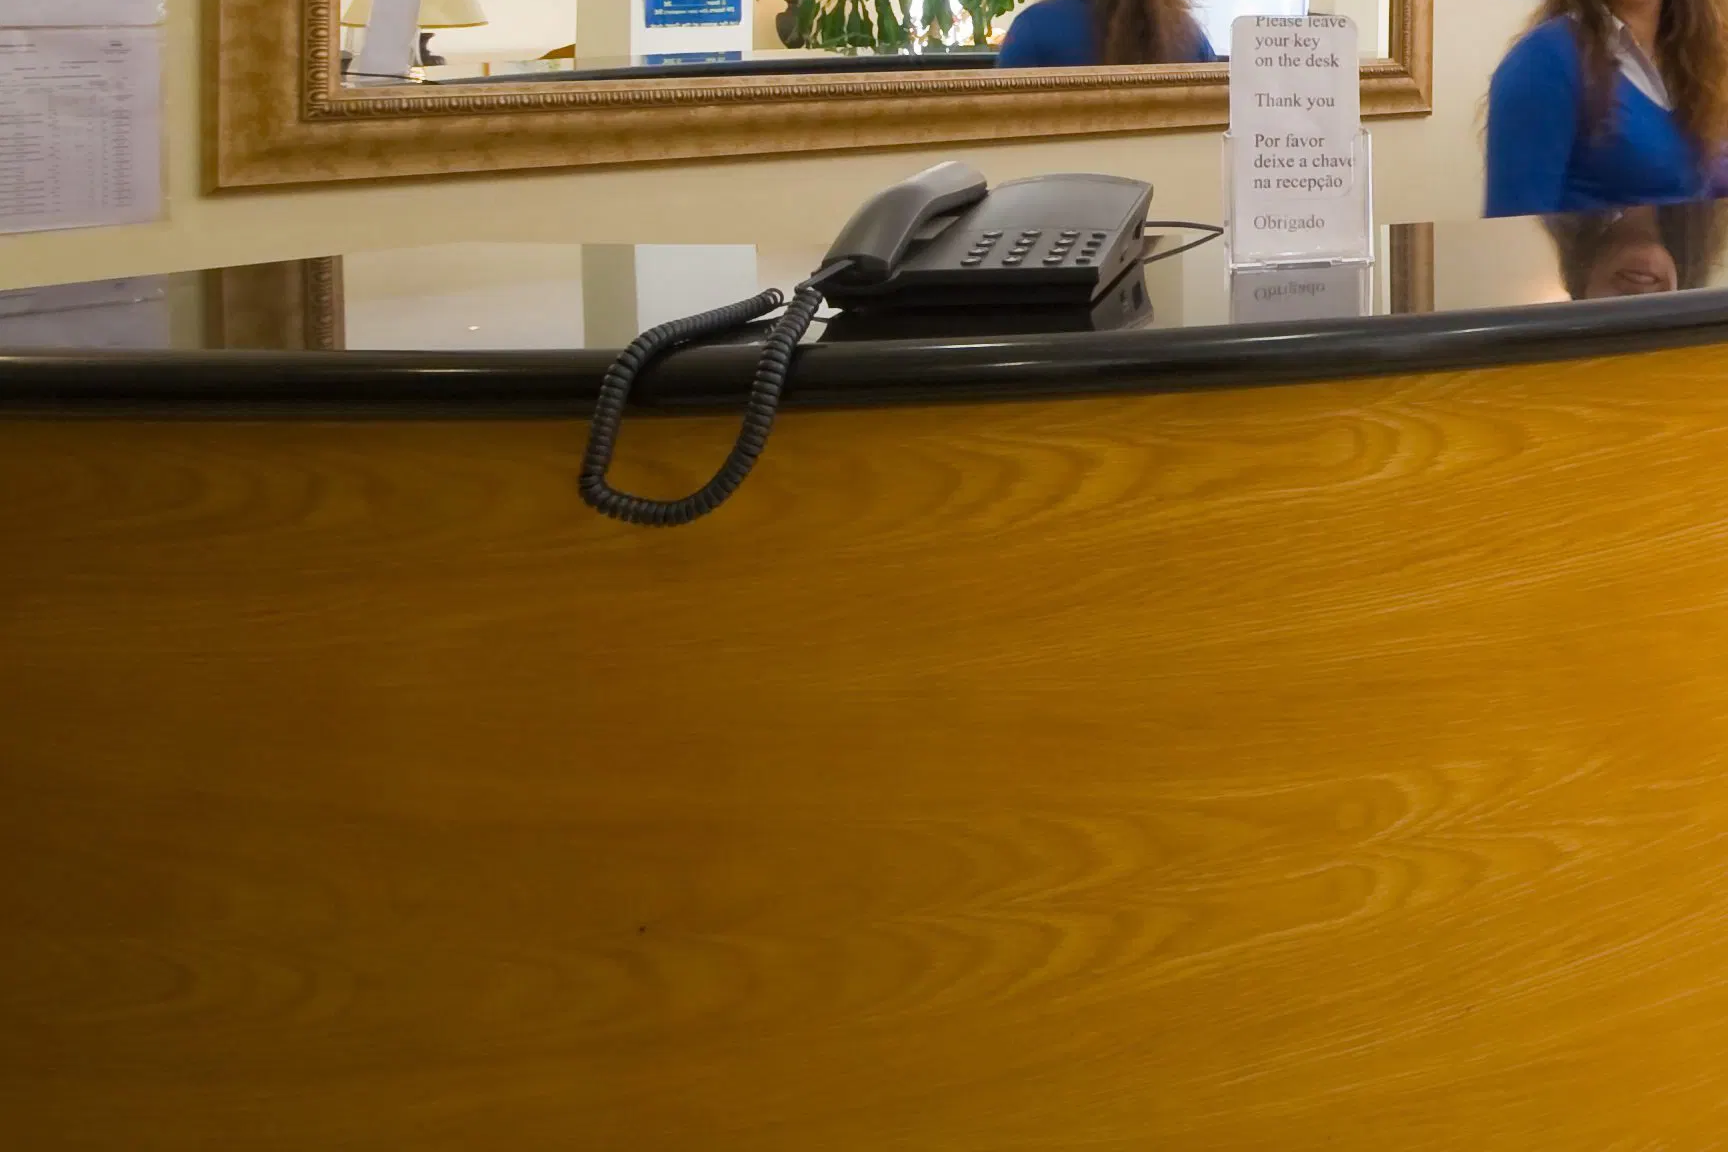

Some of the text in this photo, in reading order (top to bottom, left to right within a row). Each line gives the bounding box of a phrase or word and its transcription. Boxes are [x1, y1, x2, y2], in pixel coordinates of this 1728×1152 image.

[1255, 16, 1347, 28] Please leave
[1255, 33, 1321, 51] your key
[1254, 53, 1340, 67] on the desk
[1254, 92, 1335, 111] Thank you
[1254, 133, 1325, 148] Por favor
[1253, 153, 1295, 168] deixe
[1299, 157, 1308, 168] a
[1253, 174, 1343, 192] na recepção
[1253, 214, 1325, 233] Obrigado
